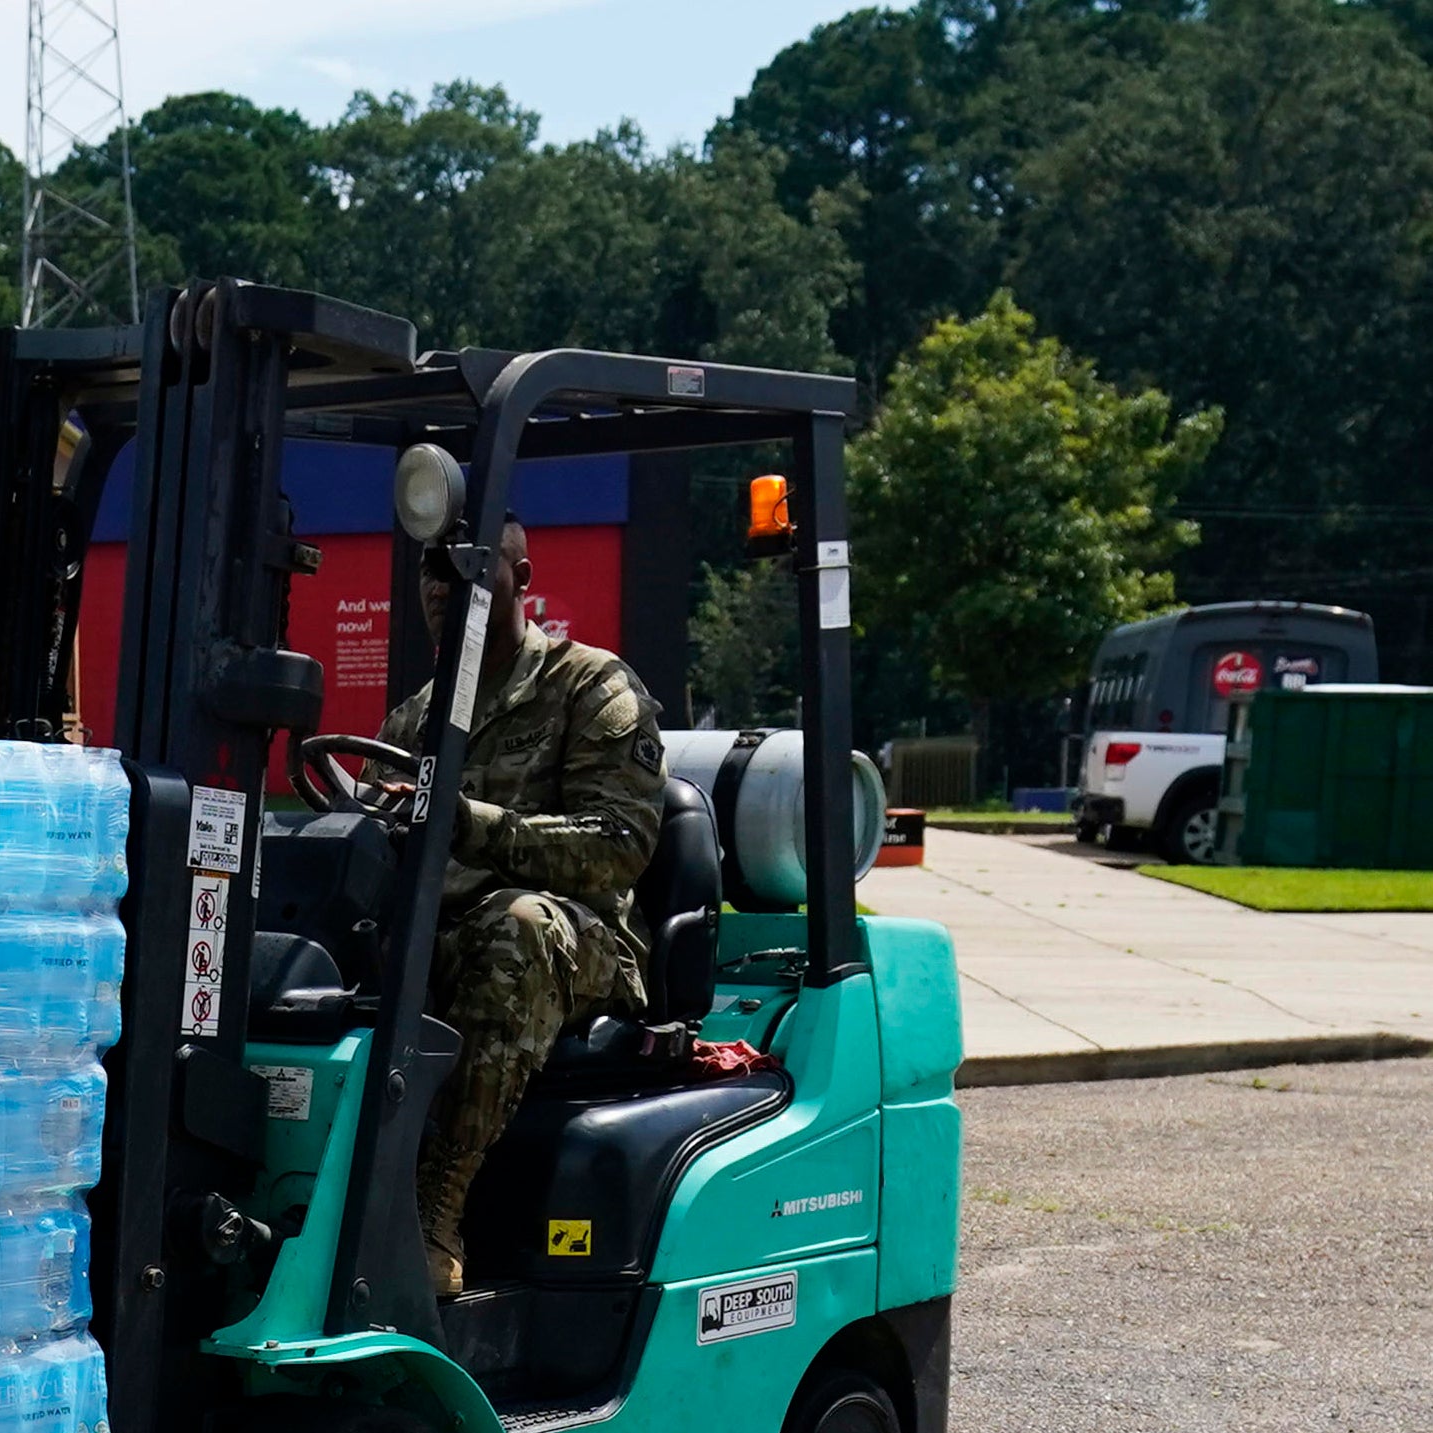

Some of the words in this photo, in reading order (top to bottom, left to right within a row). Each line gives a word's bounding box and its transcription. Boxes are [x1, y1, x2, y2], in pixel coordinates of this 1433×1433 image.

[337, 599, 366, 613] And
[337, 619, 372, 633] now!
[420, 758, 433, 787] 3
[414, 792, 428, 821] 2
[782, 1189, 863, 1216] MITSUBISHI
[724, 1292, 753, 1312] DEEP
[756, 1284, 792, 1305] SOUTH
[730, 1303, 785, 1322] EQUIPMENT
